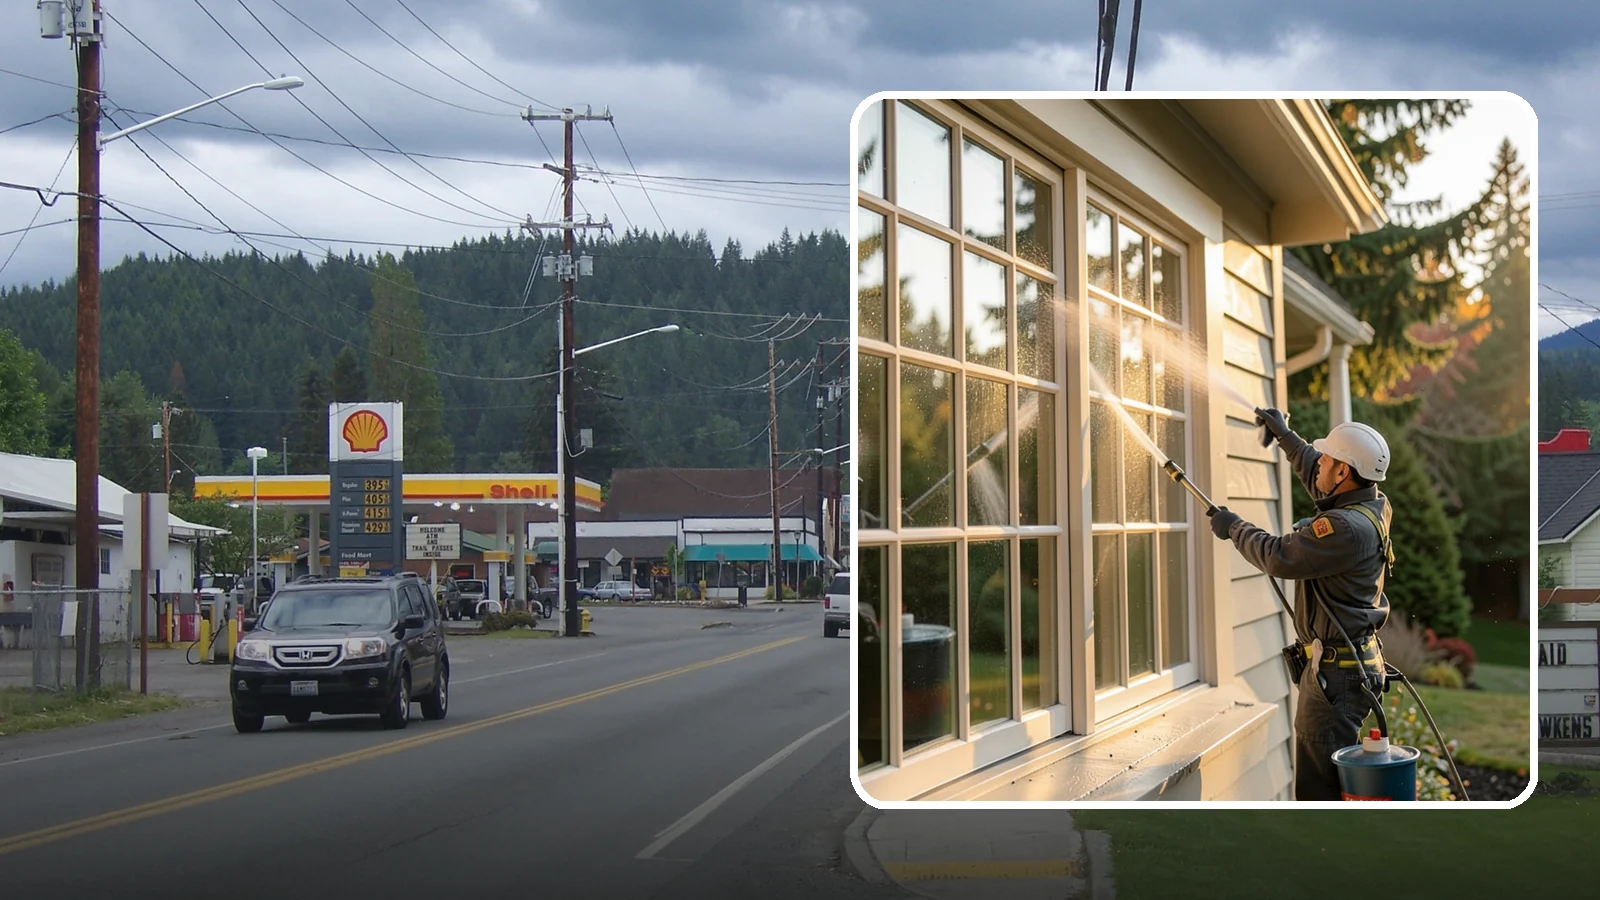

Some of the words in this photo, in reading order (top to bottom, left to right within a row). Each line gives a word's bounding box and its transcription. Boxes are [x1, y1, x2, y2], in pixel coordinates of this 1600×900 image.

[365, 480, 383, 490] 395
[490, 484, 547, 499] Shell
[365, 494, 383, 504] 405
[365, 508, 383, 518] 415
[365, 522, 383, 533] 429
[1538, 643, 1566, 665] AID
